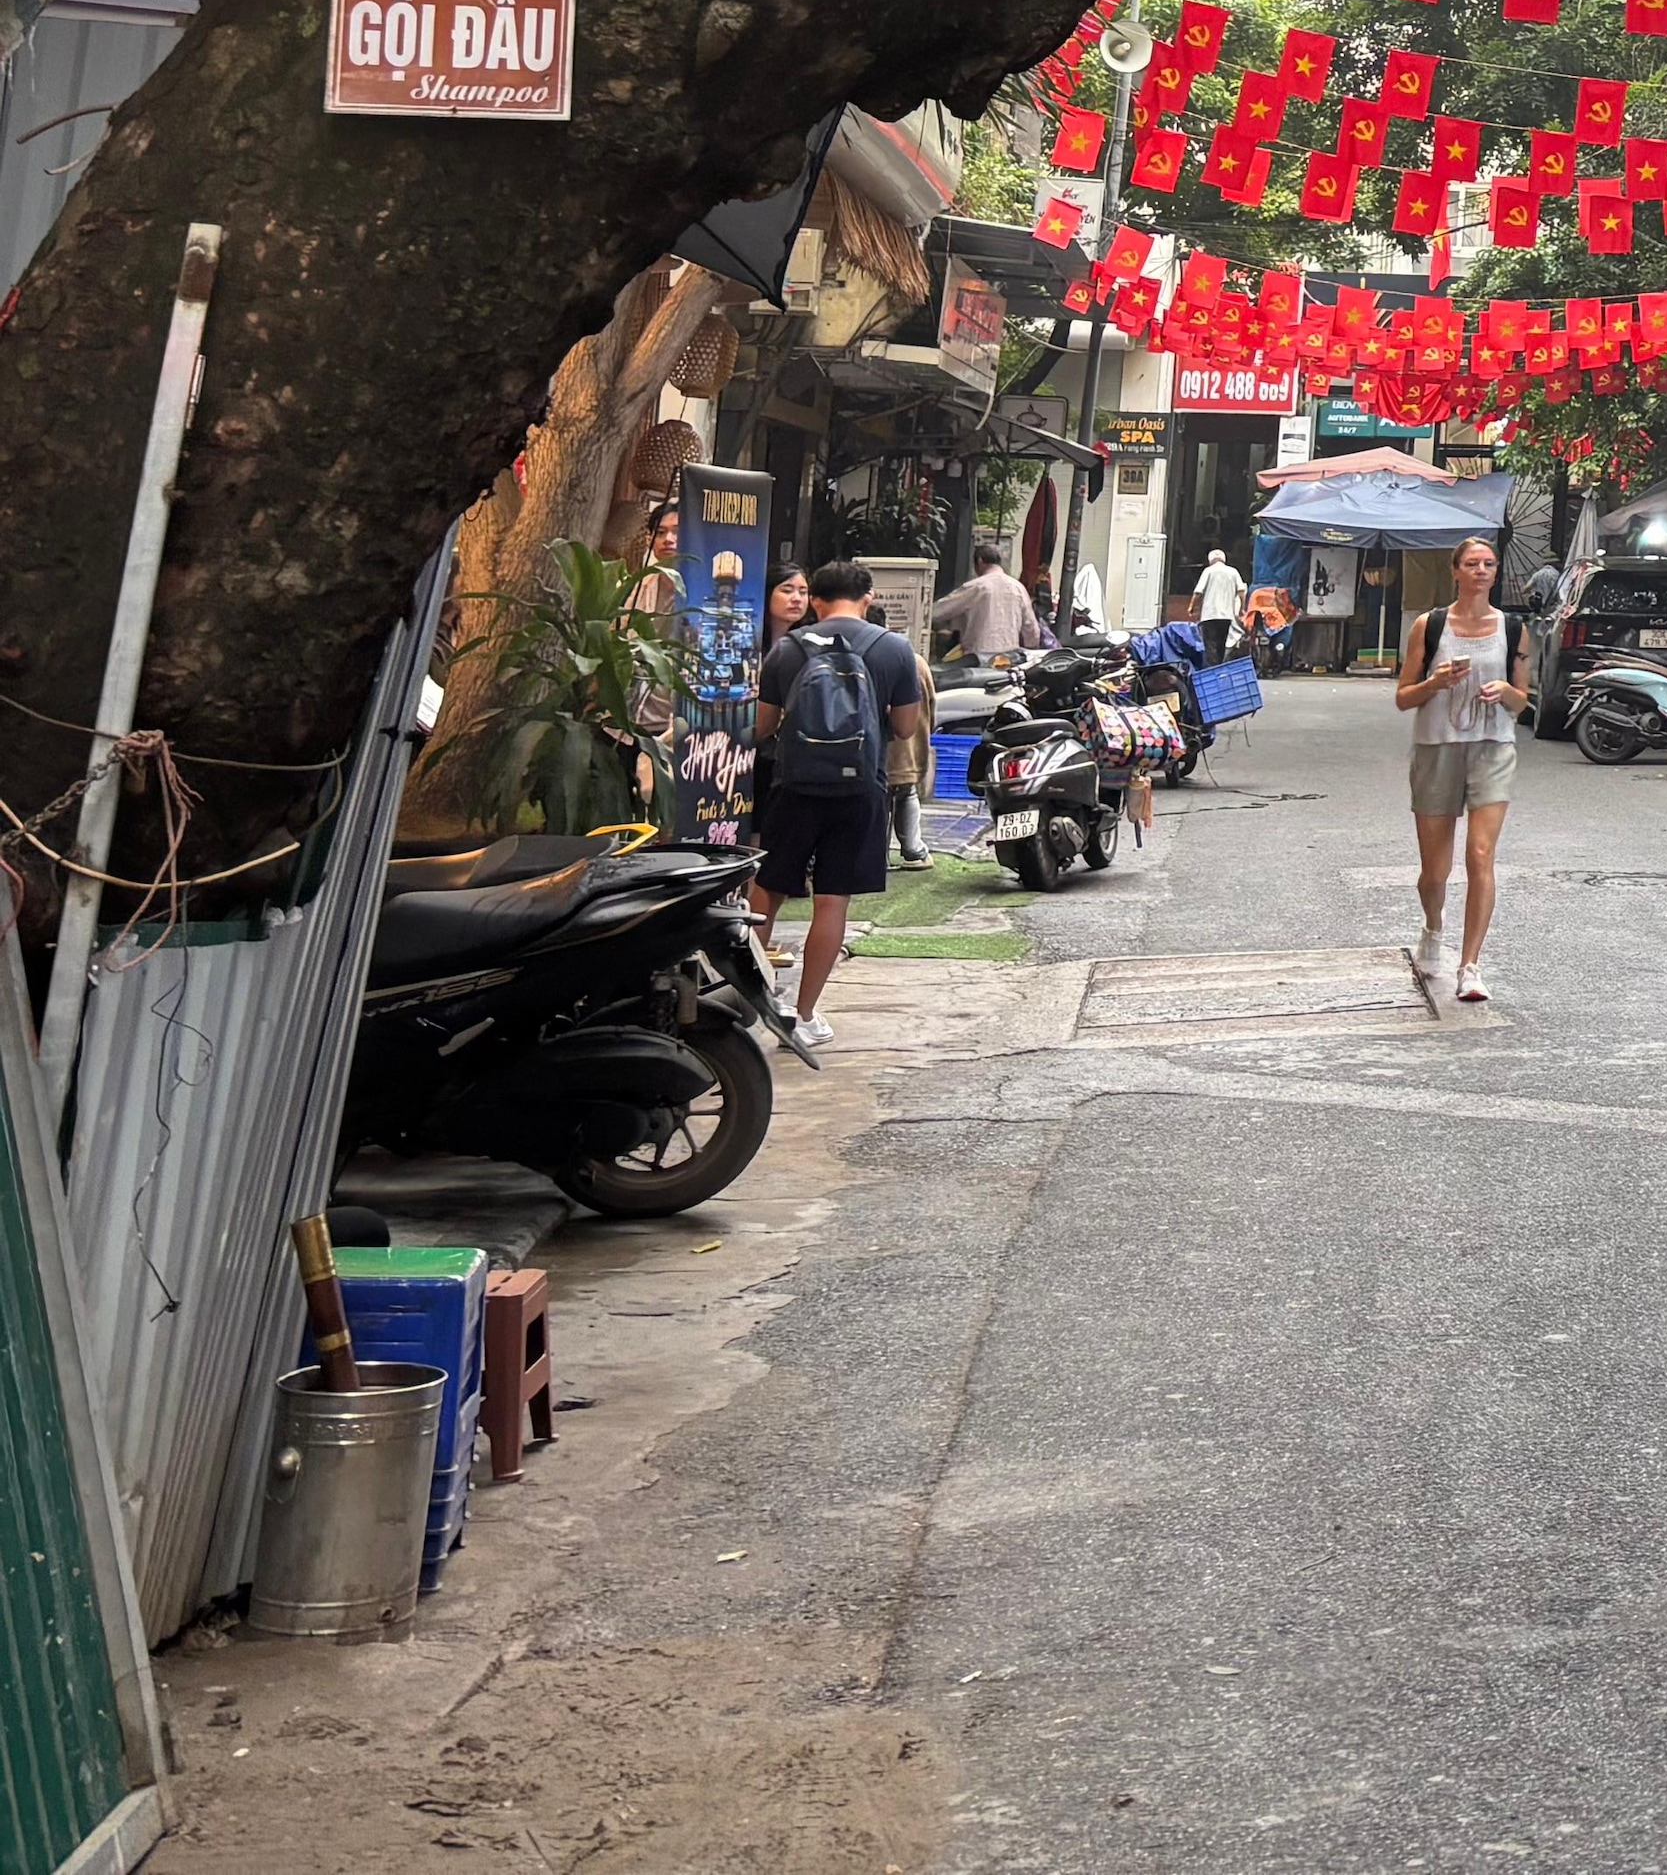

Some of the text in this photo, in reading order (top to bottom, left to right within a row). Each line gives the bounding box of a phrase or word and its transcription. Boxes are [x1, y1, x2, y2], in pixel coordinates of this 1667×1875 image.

[409, 74, 552, 108] Shampoo
[1180, 370, 1255, 402] 0912 488
[1120, 430, 1156, 444] SPA
[1138, 417, 1166, 431] Oasis
[681, 730, 731, 783] Happy
